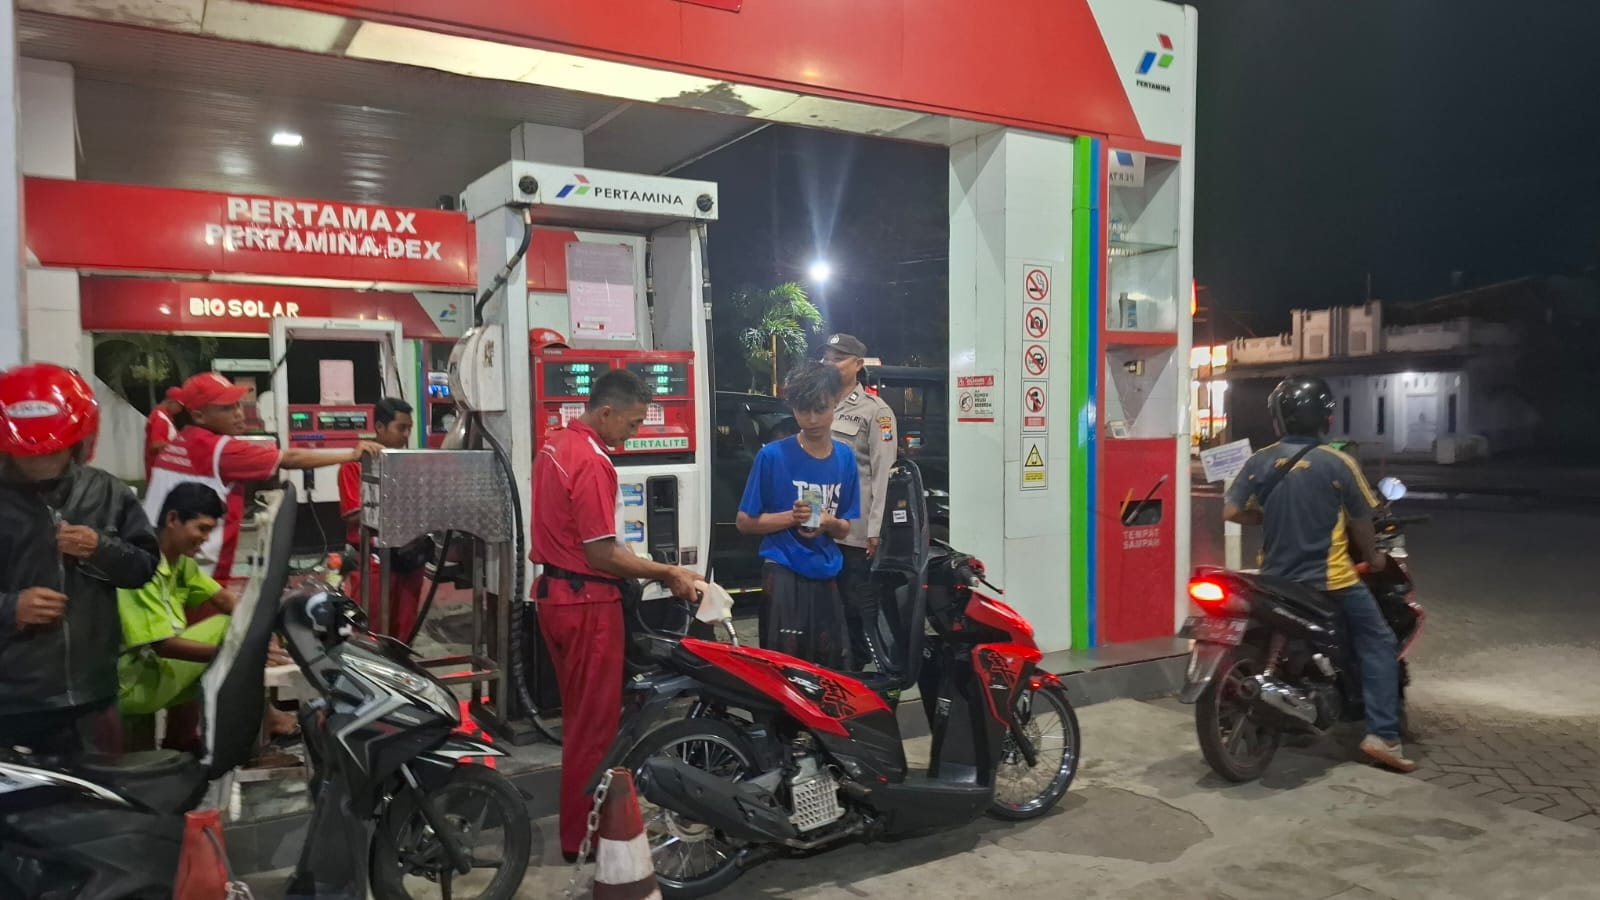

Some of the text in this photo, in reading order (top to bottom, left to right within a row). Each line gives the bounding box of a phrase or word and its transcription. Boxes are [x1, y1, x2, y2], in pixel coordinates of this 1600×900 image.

[1136, 79, 1171, 93] PERTAMINA
[594, 187, 684, 205] PERTAMINA
[227, 197, 417, 233] PERTAMAX
[205, 224, 443, 260] PERTAMINA DEX
[838, 414, 861, 423] POLRI
[625, 439, 688, 449] PERTALITE
